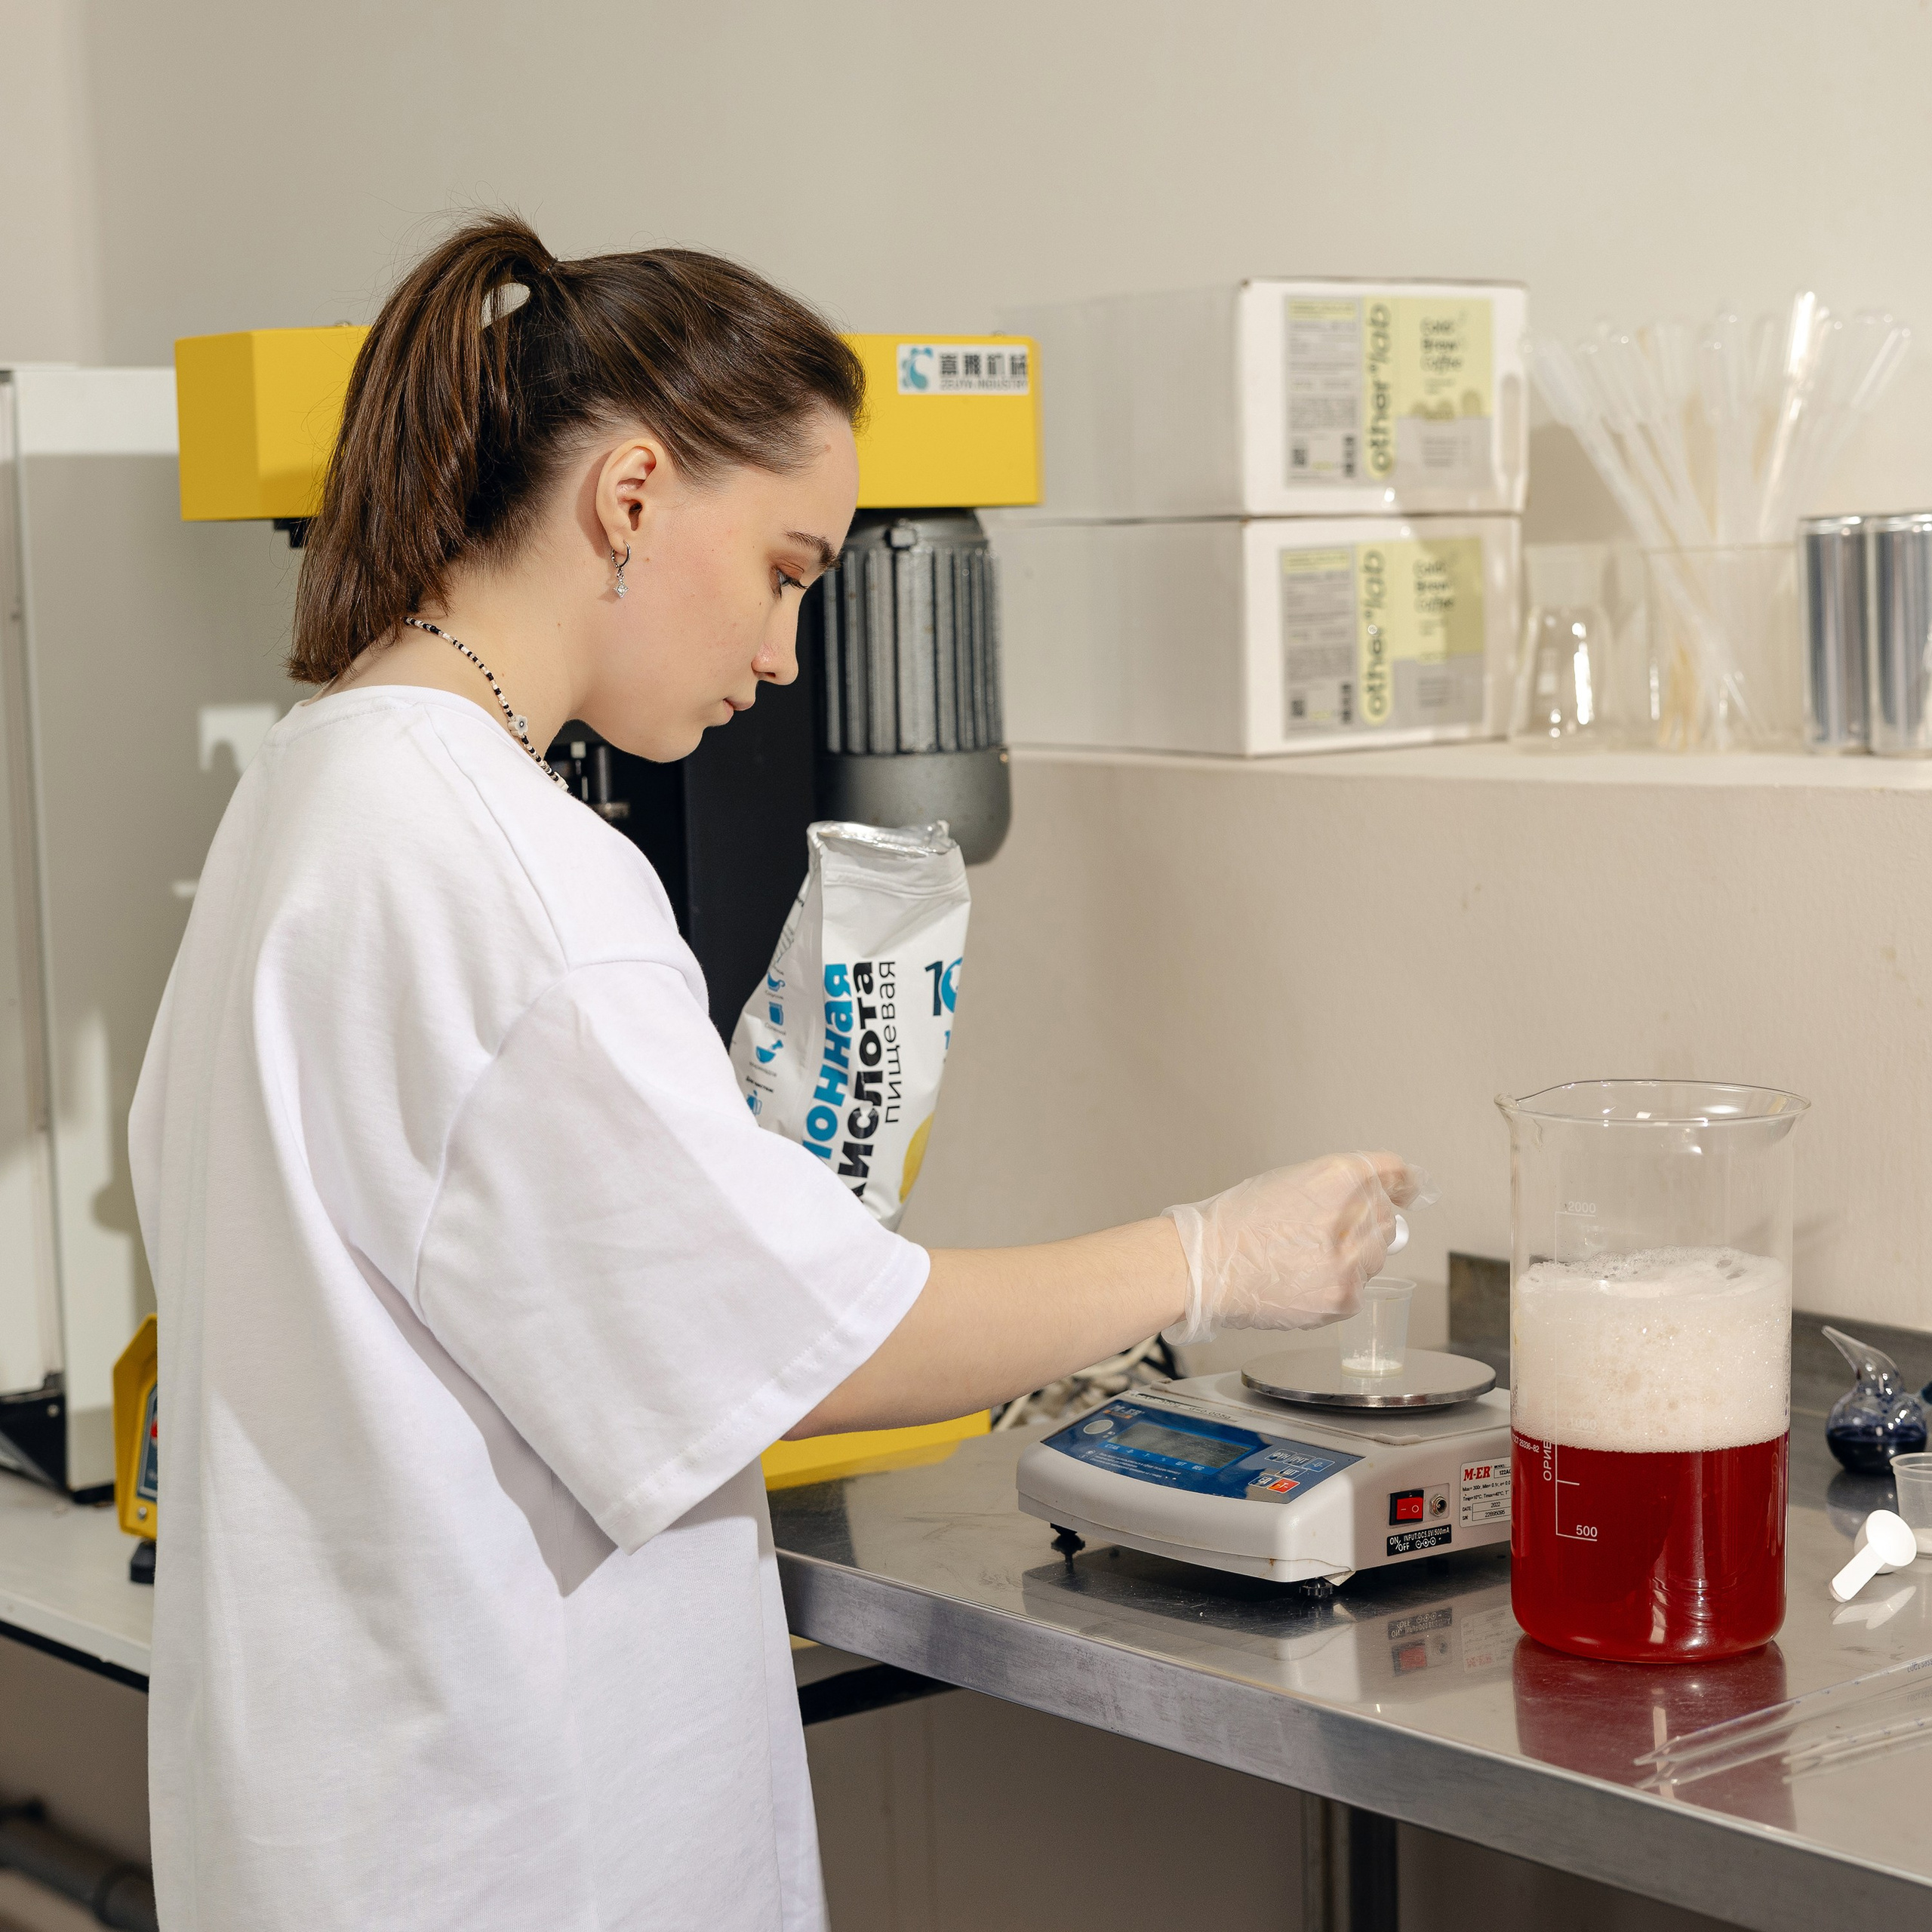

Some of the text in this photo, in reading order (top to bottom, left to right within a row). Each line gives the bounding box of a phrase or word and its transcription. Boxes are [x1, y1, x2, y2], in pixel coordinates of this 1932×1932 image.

[879, 961, 903, 1124] пищевая
[802, 963, 853, 1160] онная
[1568, 1201, 1596, 1214] 2000
[1463, 1466, 1491, 1481] M-ER
[1576, 1524, 1598, 1537] 500
